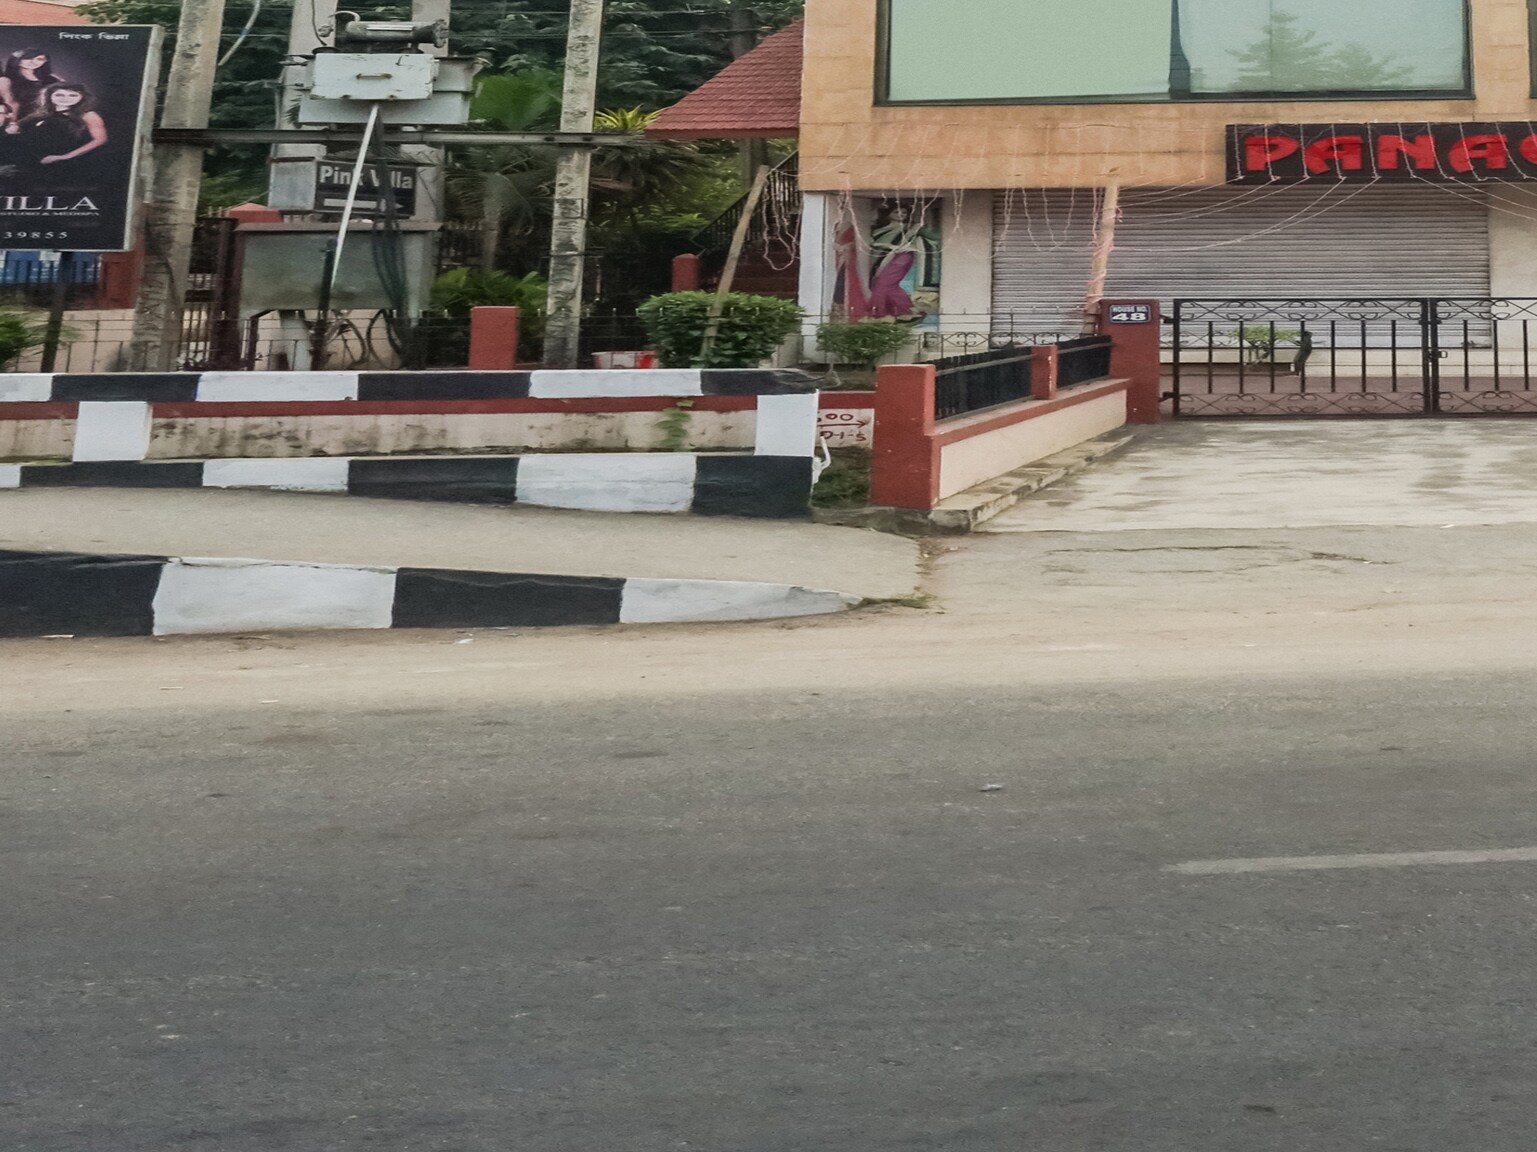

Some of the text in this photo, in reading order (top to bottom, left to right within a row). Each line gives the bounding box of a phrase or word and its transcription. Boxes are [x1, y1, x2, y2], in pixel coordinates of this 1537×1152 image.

[370, 169, 412, 189] Vlla
[0, 196, 100, 210] ILLA
[3, 231, 68, 239] 39855
[1111, 312, 1147, 321] 48
